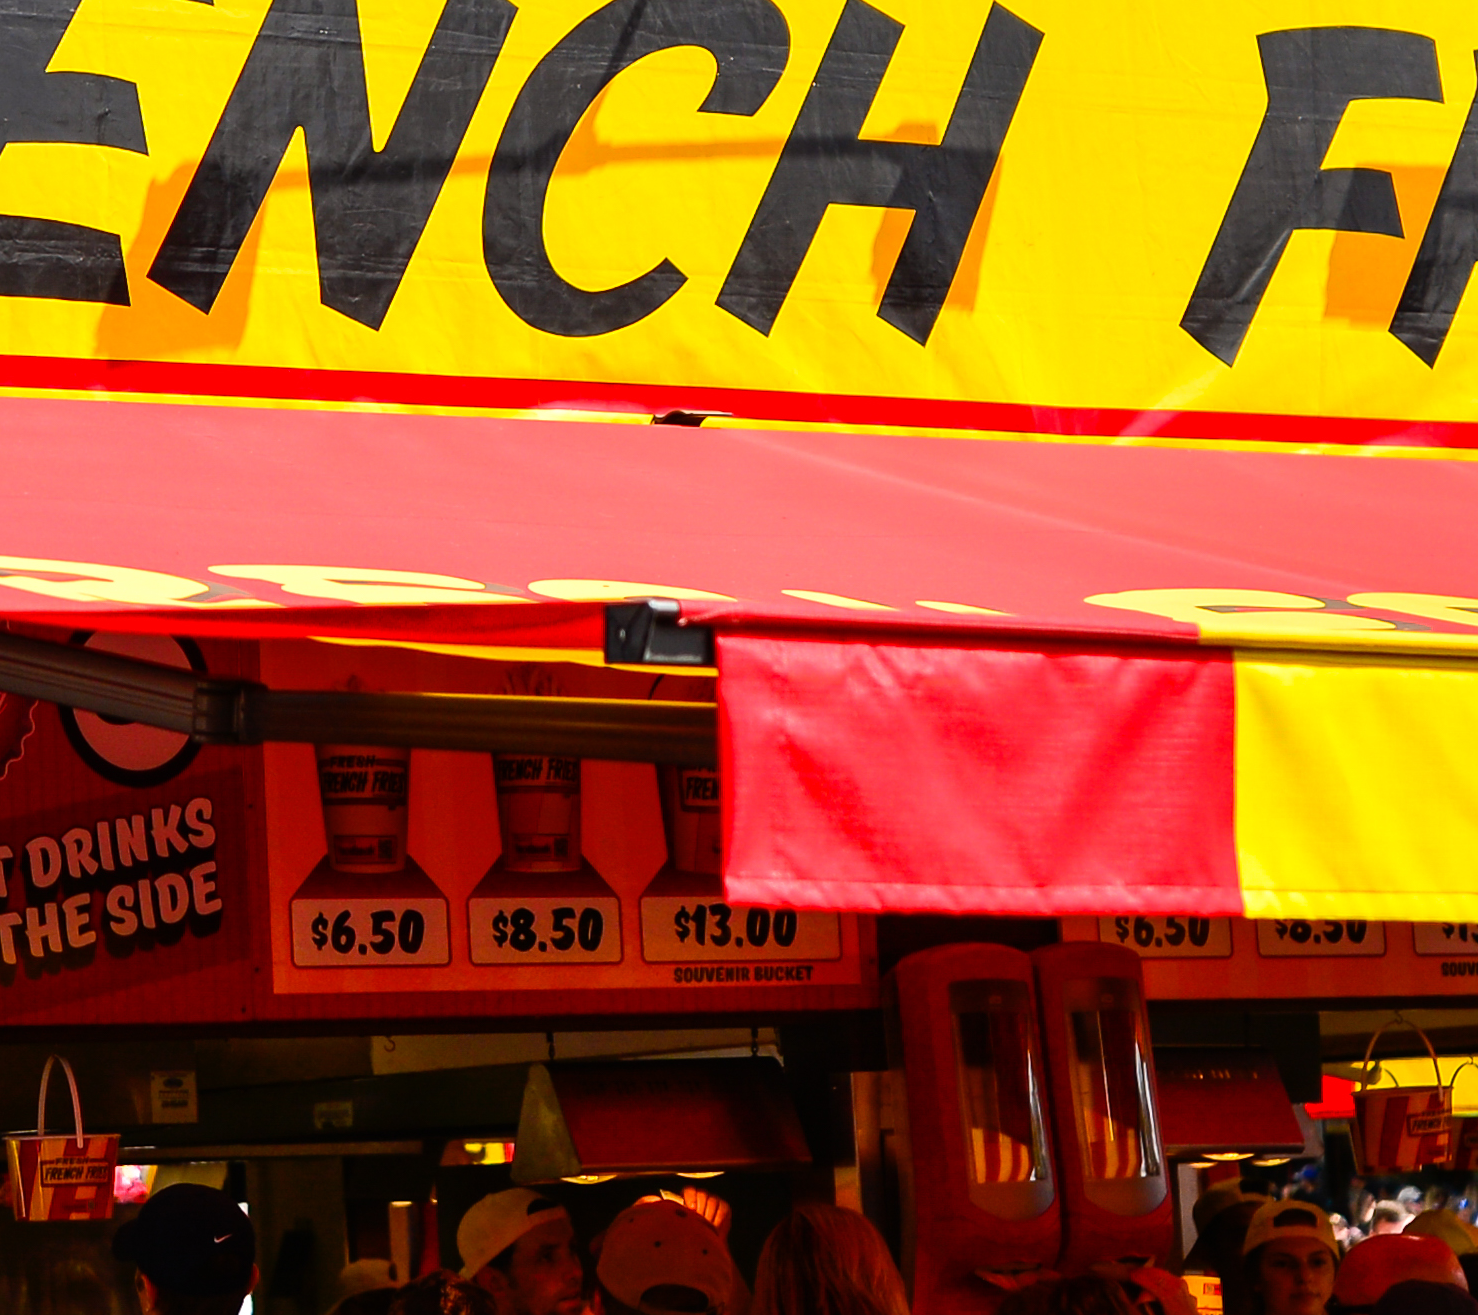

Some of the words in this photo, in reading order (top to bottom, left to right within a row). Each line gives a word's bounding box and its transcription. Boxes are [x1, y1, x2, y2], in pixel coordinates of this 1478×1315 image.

[30, 797, 215, 890] DRINKS
[109, 862, 222, 940] SIDE
[310, 909, 424, 957] $6.50
[491, 907, 603, 955] $8.50
[673, 904, 797, 950] $13.00
[672, 967, 754, 984] SOUVENIR
[757, 965, 814, 982] BUCKET
[45, 1166, 82, 1181] FRENCH
